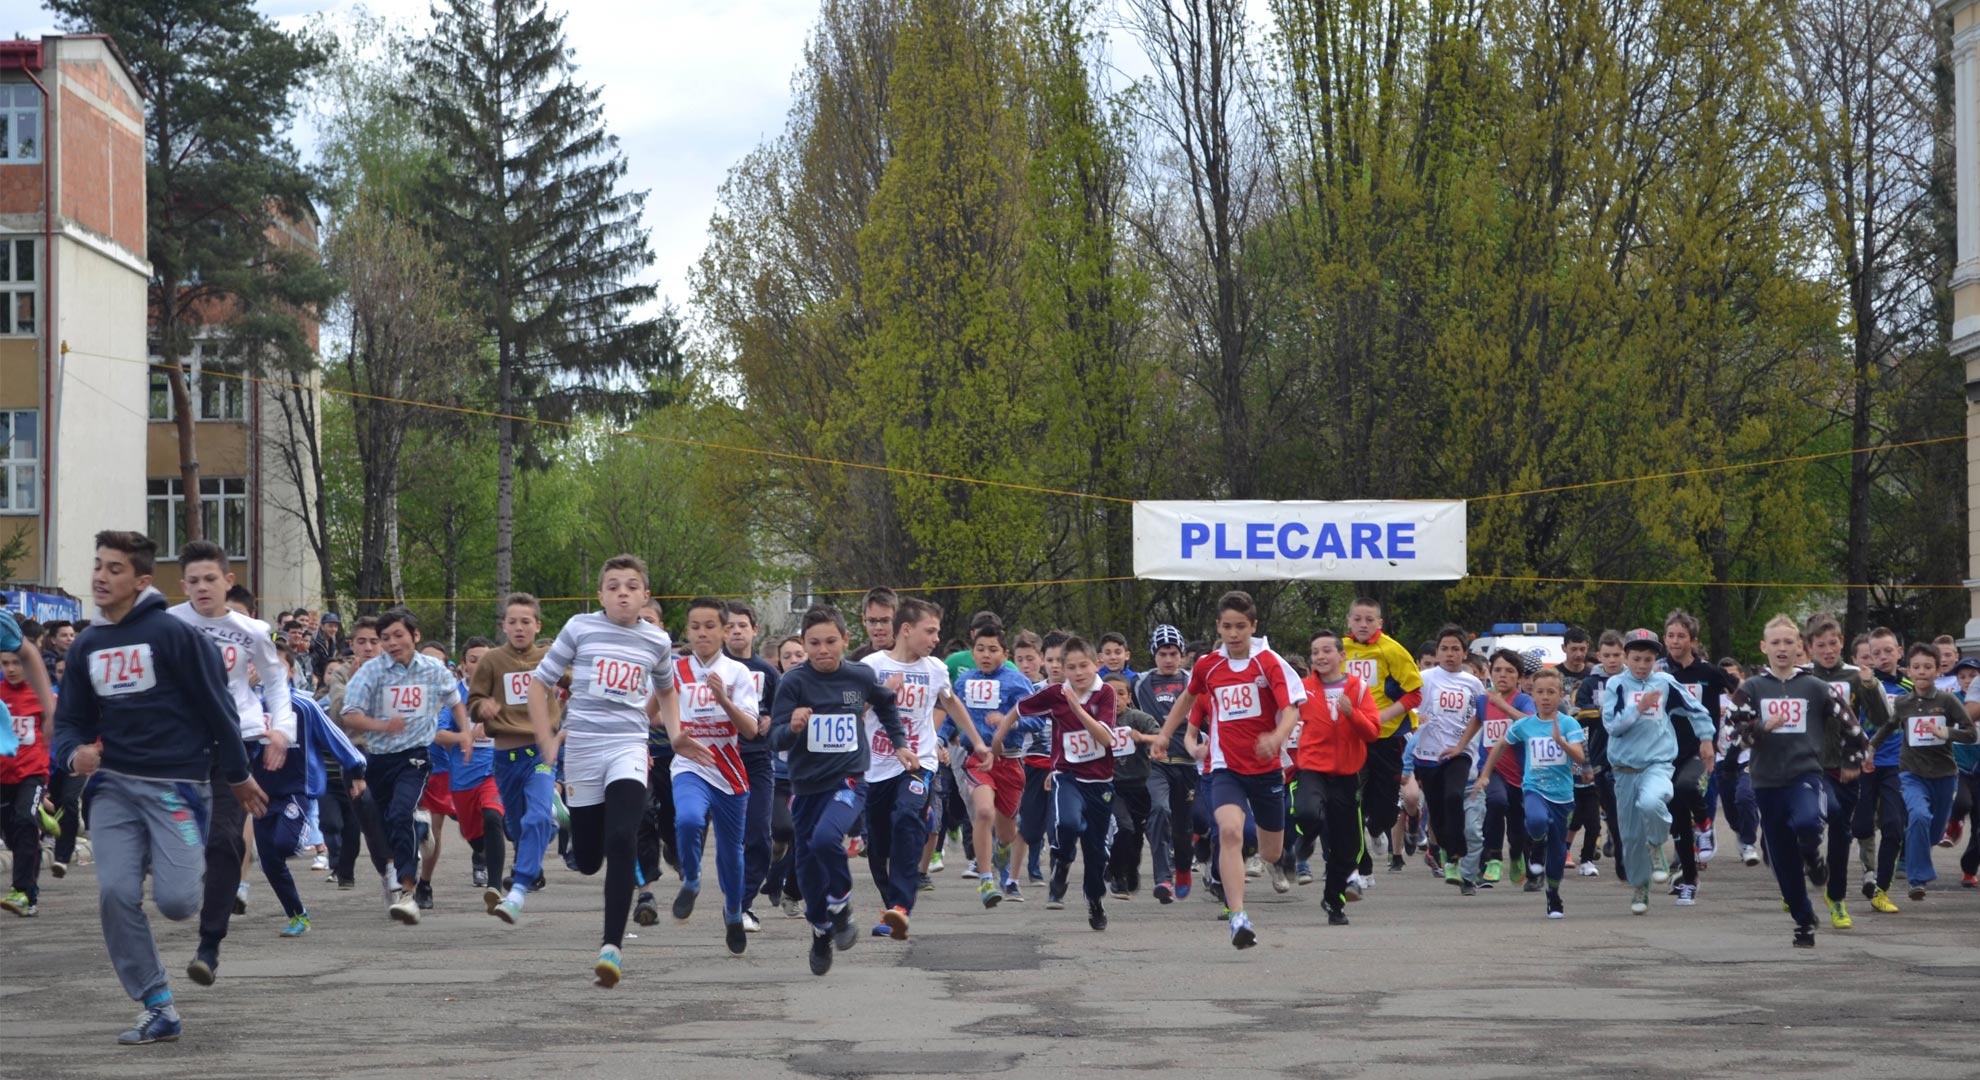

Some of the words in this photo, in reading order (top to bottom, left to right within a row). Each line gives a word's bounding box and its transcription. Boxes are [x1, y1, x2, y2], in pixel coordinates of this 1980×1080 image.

[1180, 522, 1416, 560] PLECARE
[98, 649, 144, 684] 724
[596, 659, 642, 692] 1020
[390, 687, 422, 708] 748
[970, 681, 993, 700] 113
[1221, 685, 1253, 711] 648
[1440, 690, 1464, 709] 603
[1768, 700, 1801, 723] 983
[813, 716, 854, 743] 1165
